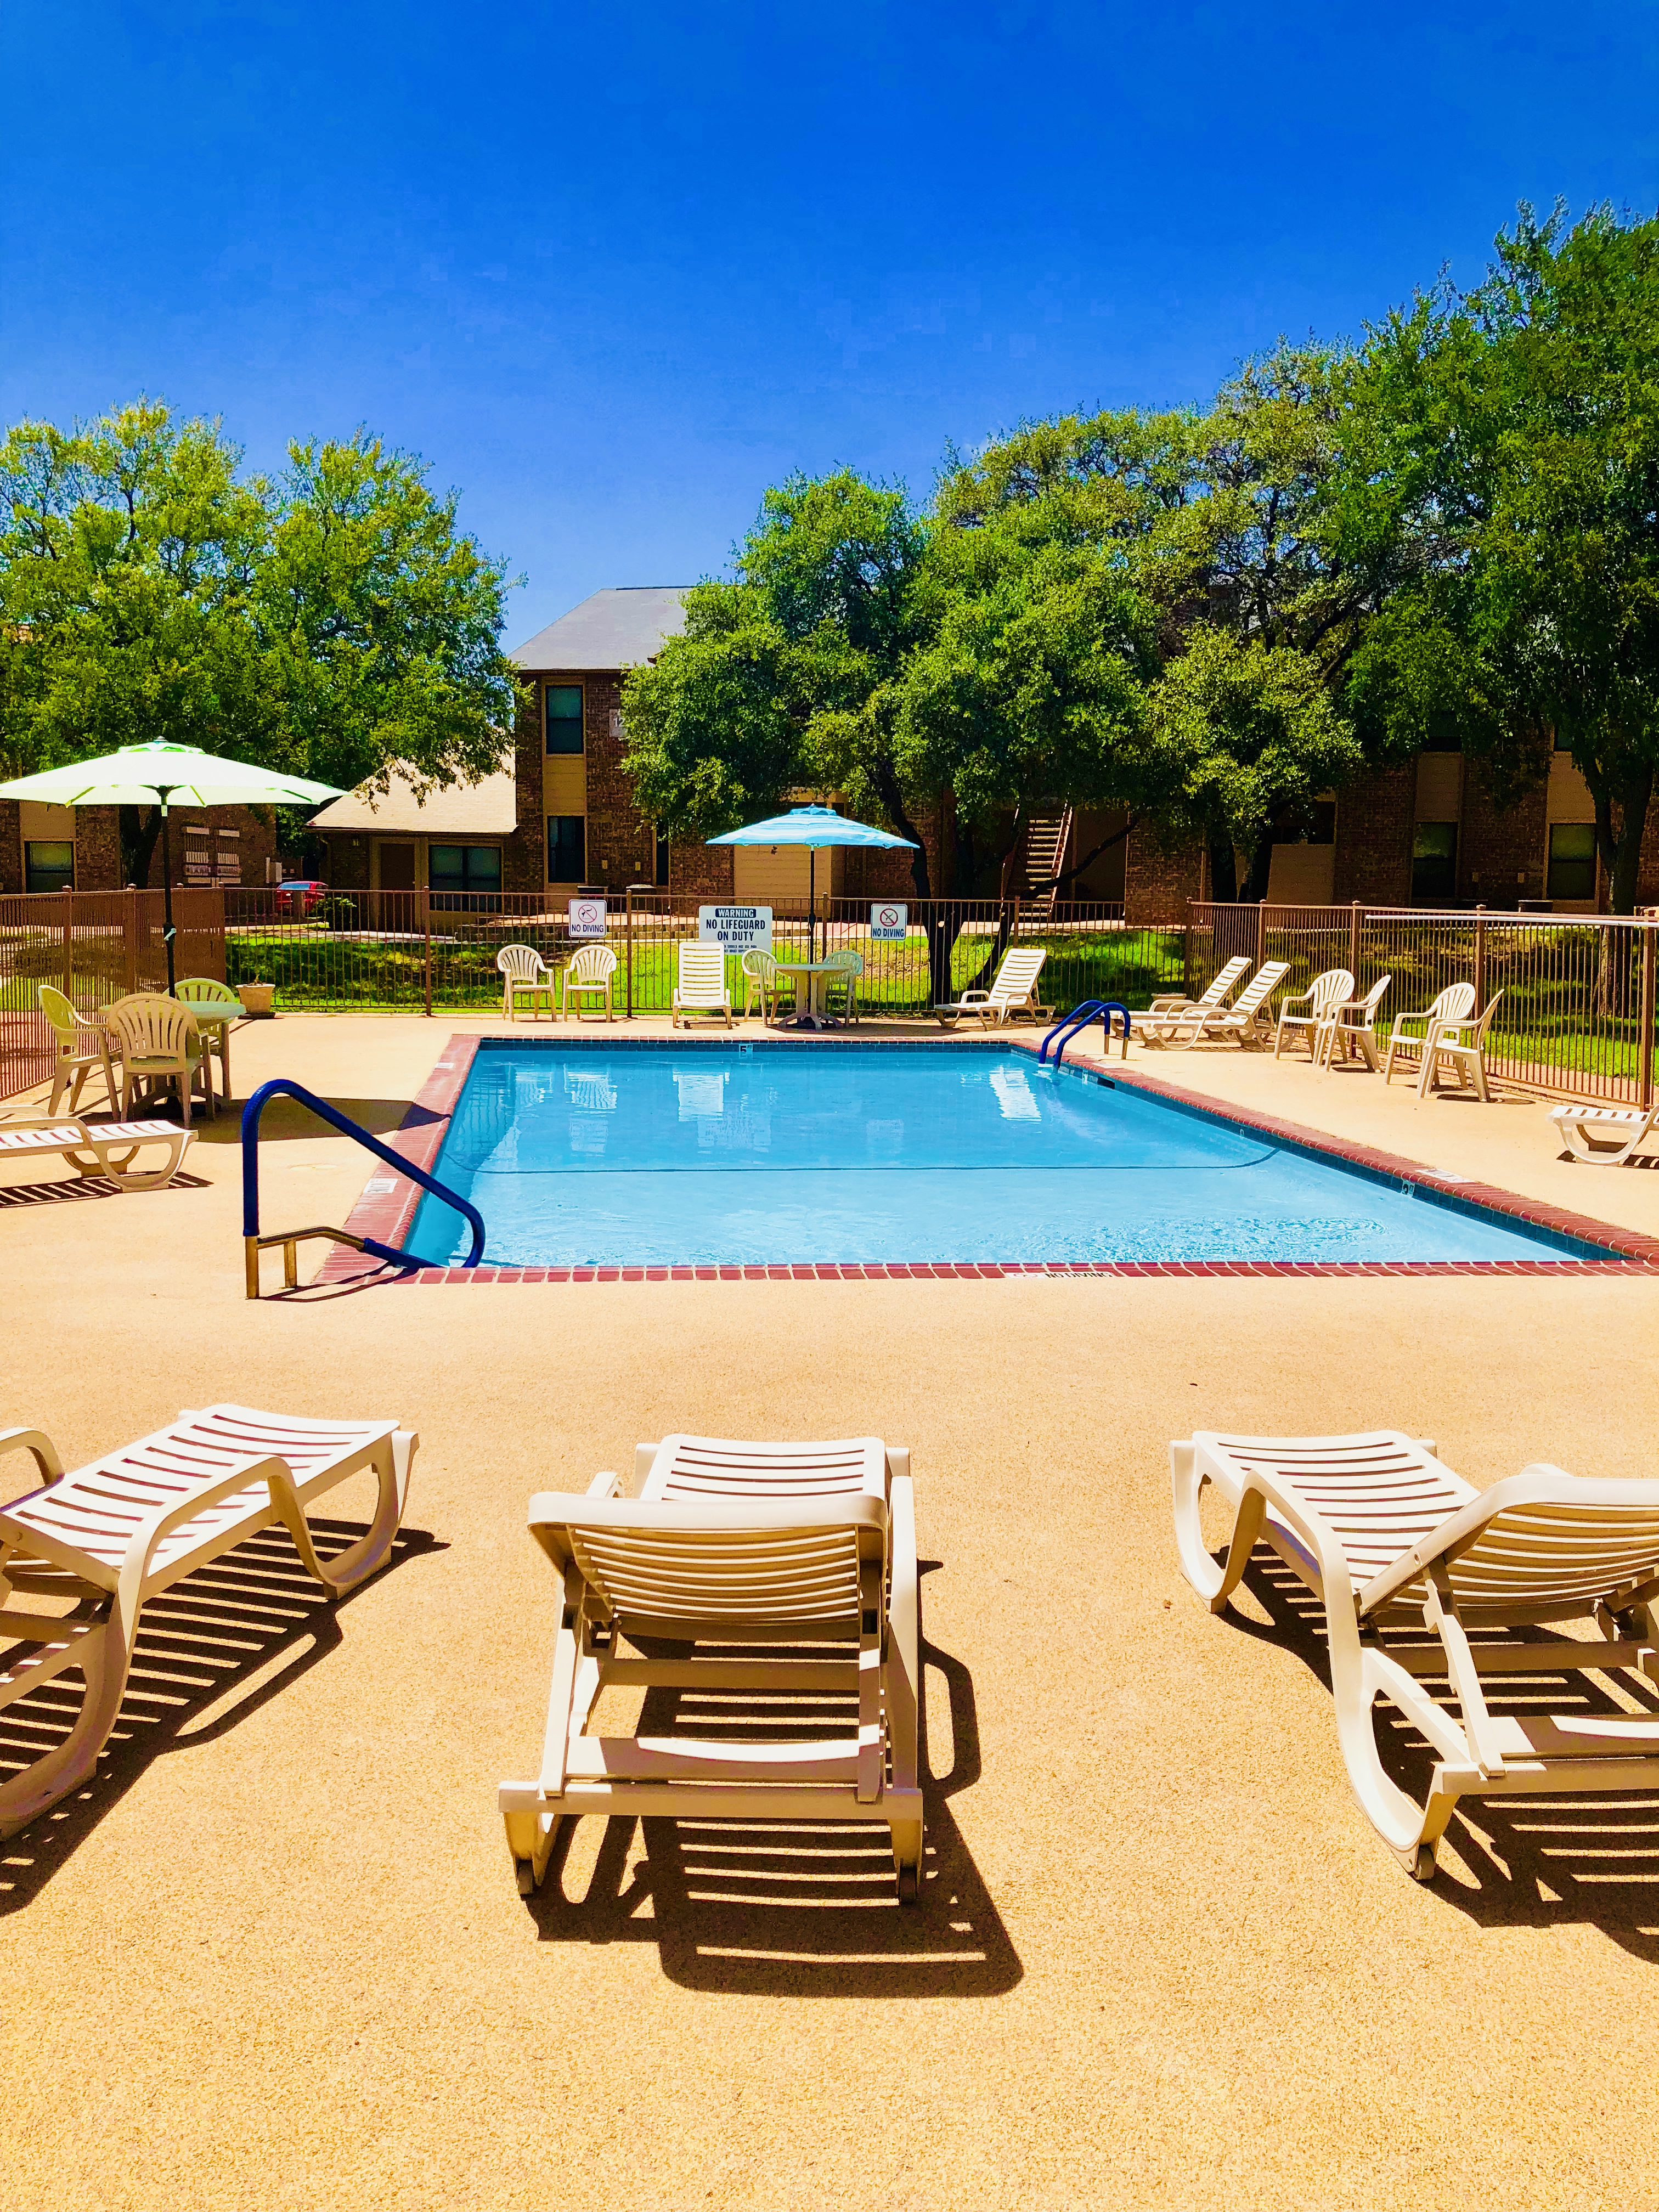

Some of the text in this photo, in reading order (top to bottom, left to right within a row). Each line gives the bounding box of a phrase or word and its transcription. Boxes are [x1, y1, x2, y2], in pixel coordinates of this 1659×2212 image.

[613, 717, 625, 727] 12
[718, 909, 754, 917] WARNING
[572, 924, 604, 933] NO DIVING
[706, 919, 765, 929] NO LIFEGUARD
[717, 931, 754, 941] ON DUTY
[872, 928, 904, 938] NO DIVING
